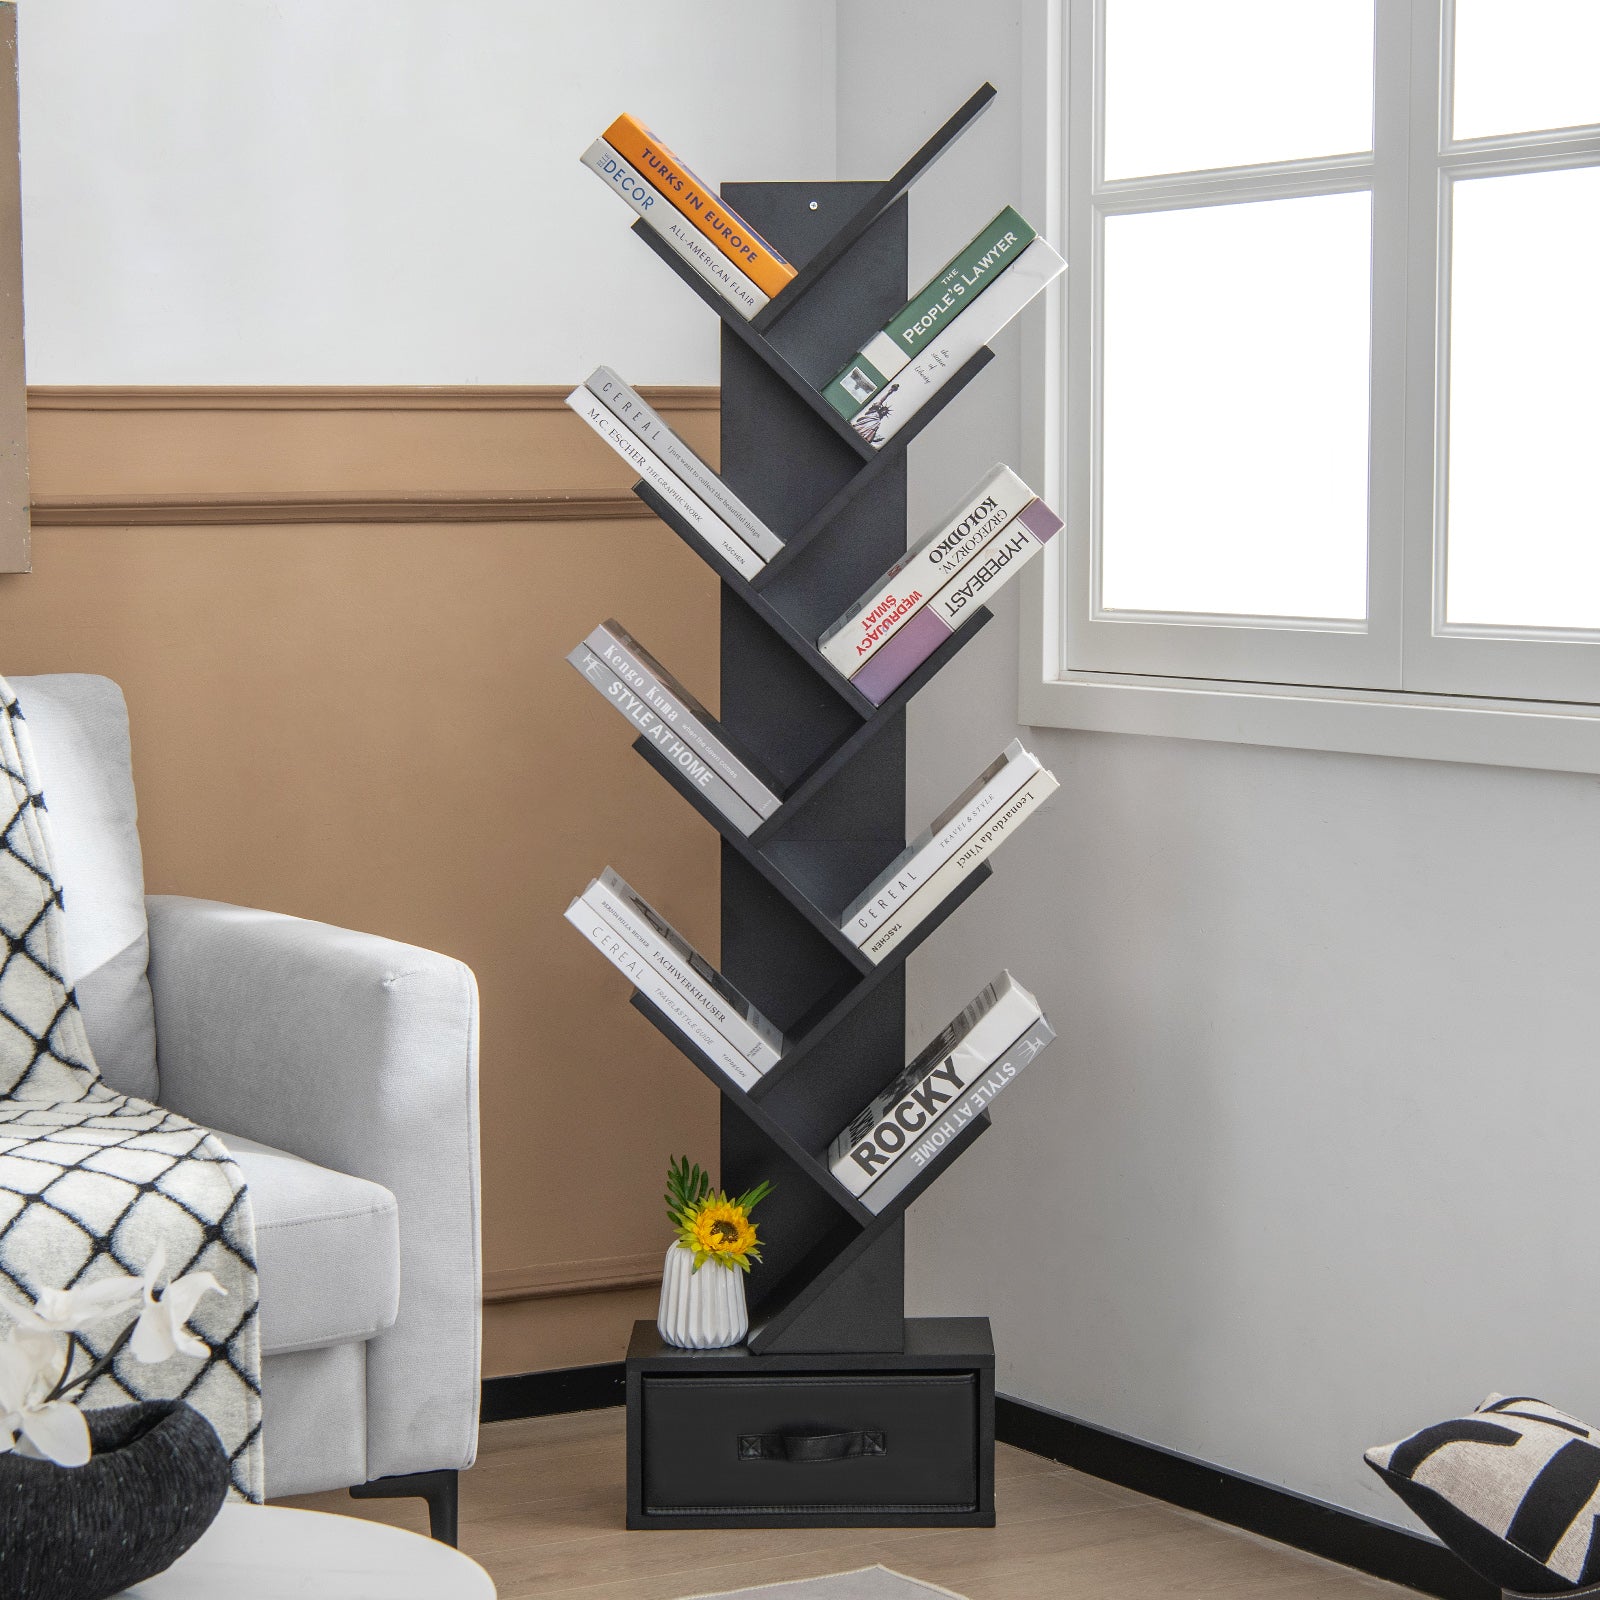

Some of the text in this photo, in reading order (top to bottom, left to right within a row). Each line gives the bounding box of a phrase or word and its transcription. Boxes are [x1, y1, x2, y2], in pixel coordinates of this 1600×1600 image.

[603, 160, 654, 210] DECOR
[642, 148, 757, 263] TURKS IN EUROPE
[670, 225, 755, 306] ALL-AMERICAN FLAIR
[903, 232, 1017, 344] PEOPLE'S LAWYER
[941, 269, 959, 285] THE
[603, 382, 660, 441] CEREAL
[588, 408, 703, 522] M.C. ESCHER THE GRAPHIC WORK
[680, 459, 694, 473] want
[699, 477, 716, 494] collect
[722, 500, 746, 523] beautiful
[744, 522, 760, 538] things
[722, 541, 746, 565] TASCHEN
[929, 497, 997, 564] KOŁODKO
[955, 510, 1008, 563] GRZEGORZ
[939, 561, 957, 574] W.
[946, 533, 1029, 617] HYPEBEAST
[857, 592, 922, 654] WĘDRUJĄCY
[862, 595, 897, 636] ŚWIAT
[604, 645, 678, 722] Kengo Kuma
[608, 682, 713, 786] STYLE AT HOME
[940, 822, 967, 848] TRAVEL
[972, 794, 993, 817] STYLE
[992, 792, 1034, 832] Leonardo
[957, 844, 983, 869] Vinci
[858, 873, 917, 928] CEREAL
[592, 927, 644, 980] CEREAL
[872, 924, 902, 953] TASCHEN
[696, 1029, 714, 1046] GUIDE
[971, 1063, 1016, 1107] STYLE
[850, 1057, 966, 1177] ROCKY
[953, 1102, 973, 1127] AT
[911, 1122, 955, 1166] HOME
